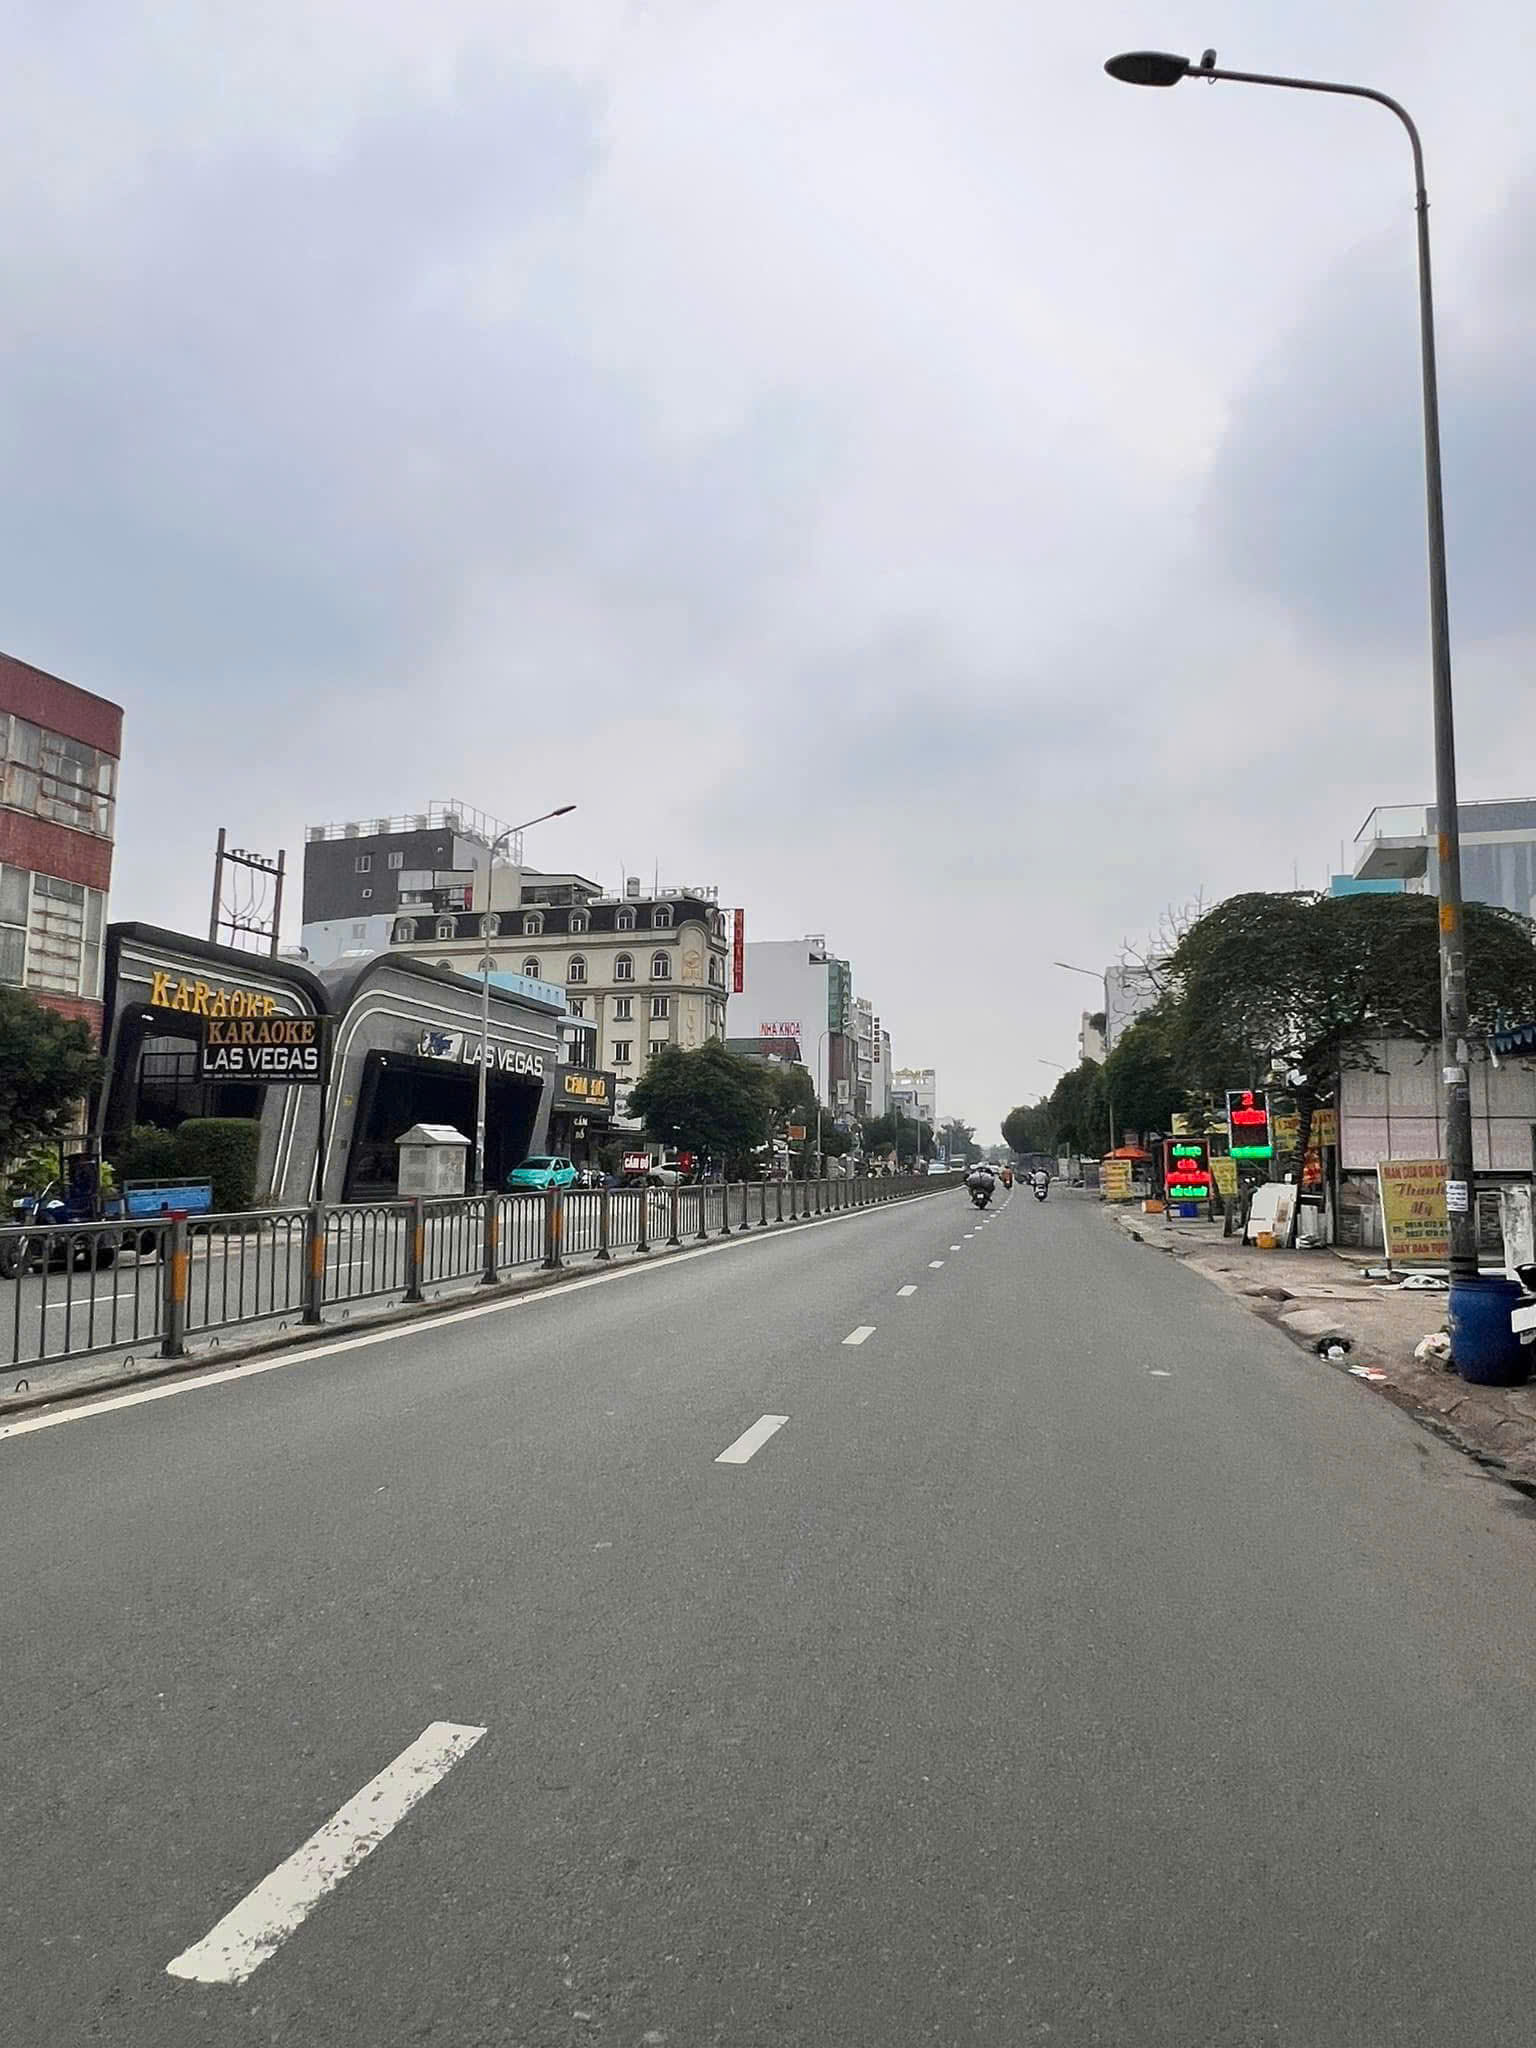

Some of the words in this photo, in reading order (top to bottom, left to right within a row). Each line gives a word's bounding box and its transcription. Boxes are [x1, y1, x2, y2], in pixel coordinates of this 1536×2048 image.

[151, 971, 277, 1016] KARAOKE
[208, 1020, 315, 1044] KARAOKE
[203, 1048, 243, 1070] LAS
[248, 1048, 318, 1070] VEGAS
[498, 1047, 544, 1077] VEGAS
